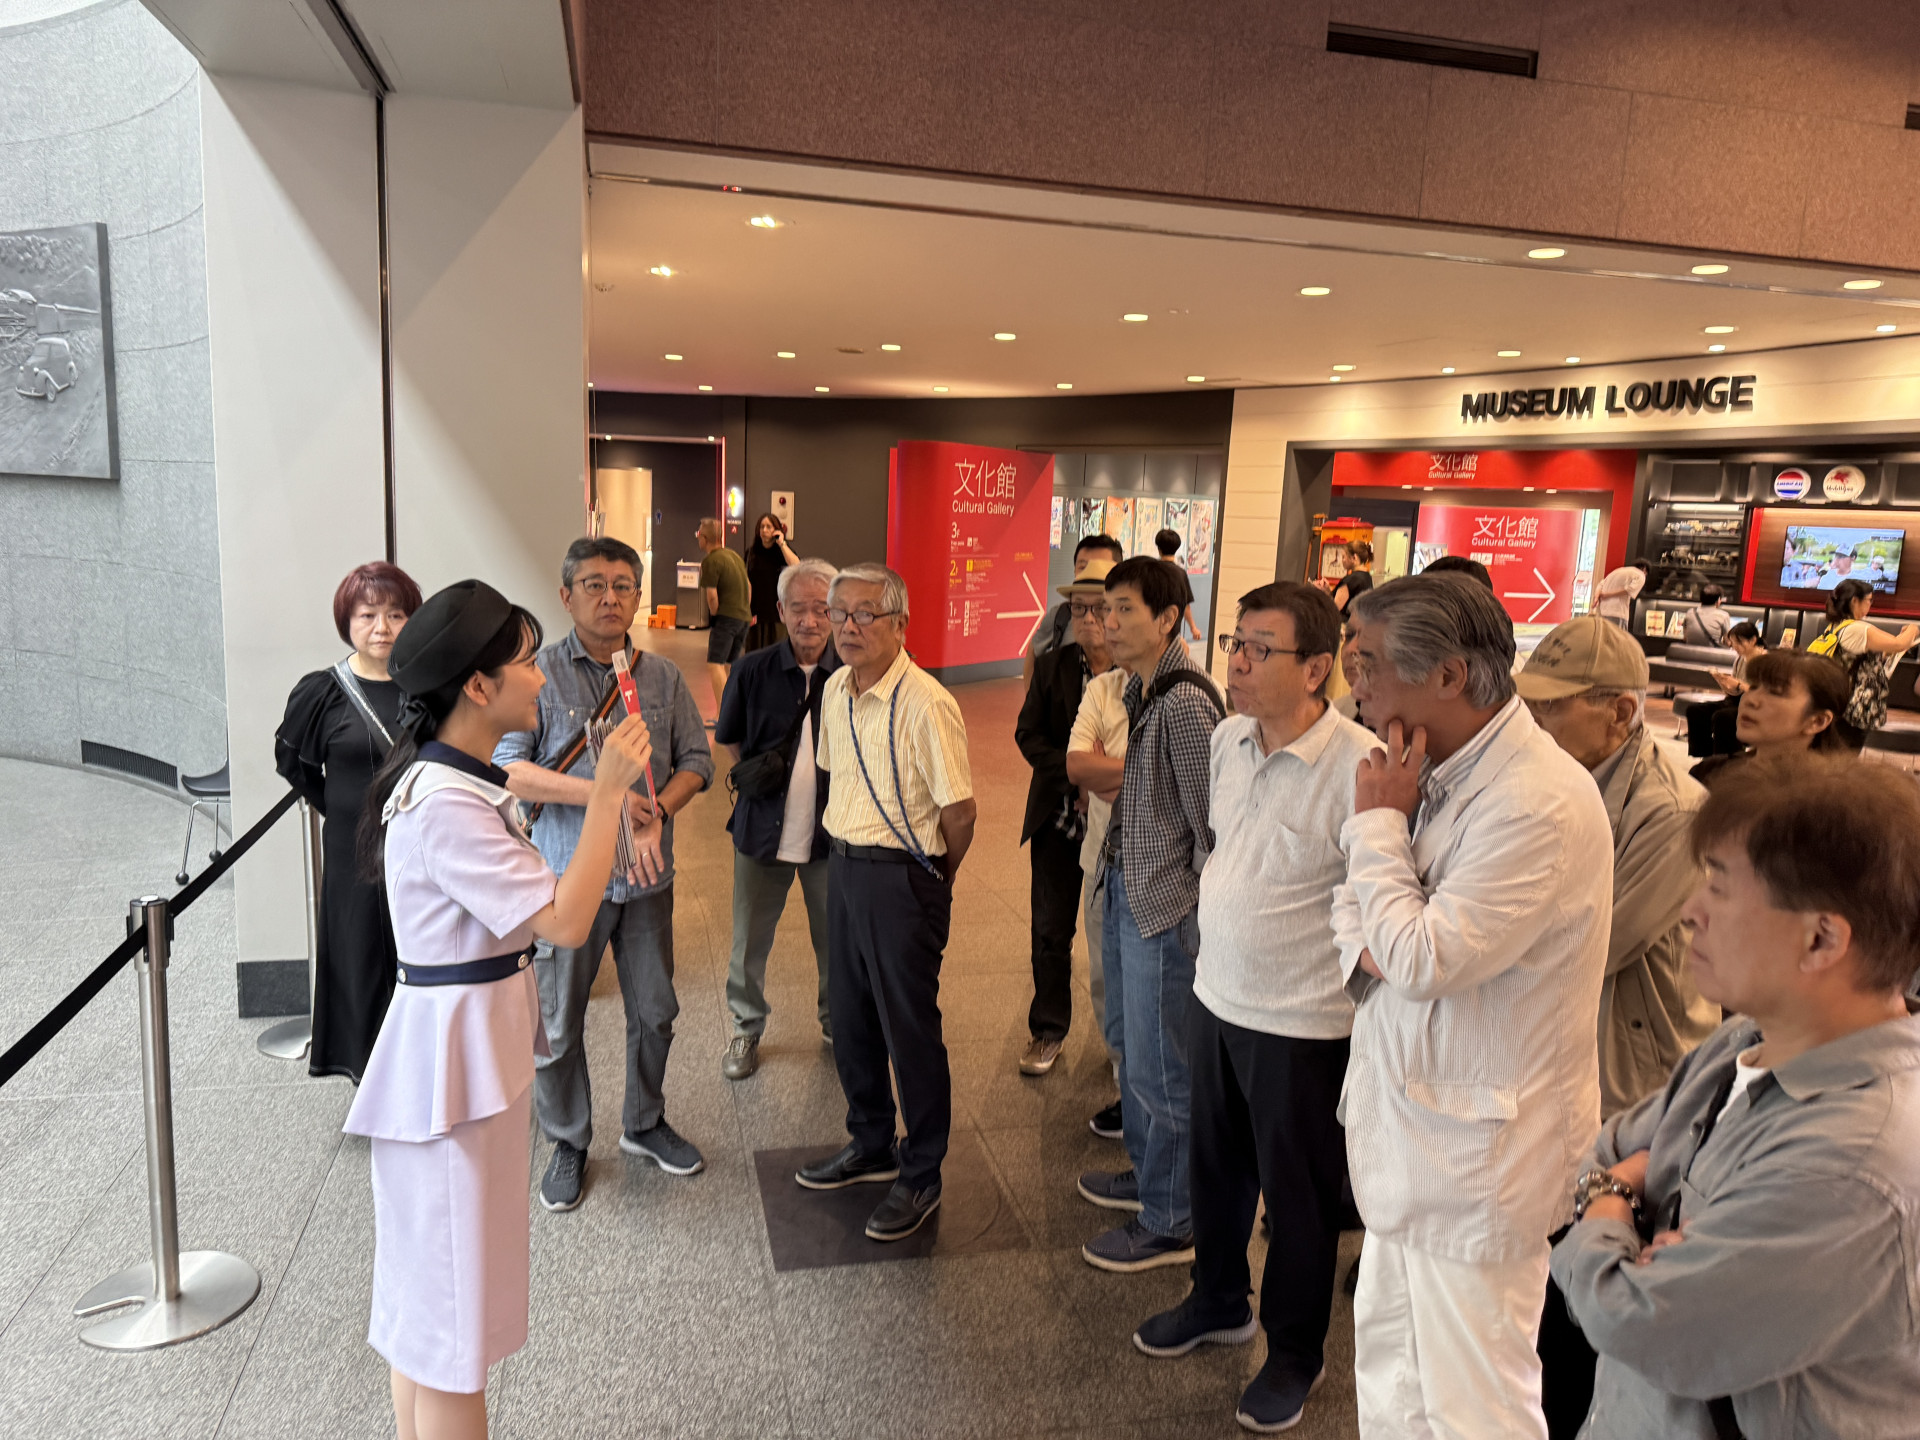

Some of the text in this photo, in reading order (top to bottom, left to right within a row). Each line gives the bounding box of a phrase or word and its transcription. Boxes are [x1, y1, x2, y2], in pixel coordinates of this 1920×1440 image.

[1460, 374, 1757, 421] MUSEUM LOUNGE
[1429, 453, 1478, 472] 文化館
[953, 457, 1017, 500] 文化館
[1428, 471, 1476, 480] Cultural Gallery
[952, 499, 1015, 517] Cultural Gallery
[1473, 514, 1539, 540] 文化館
[1471, 537, 1536, 549] Cultural Gallery
